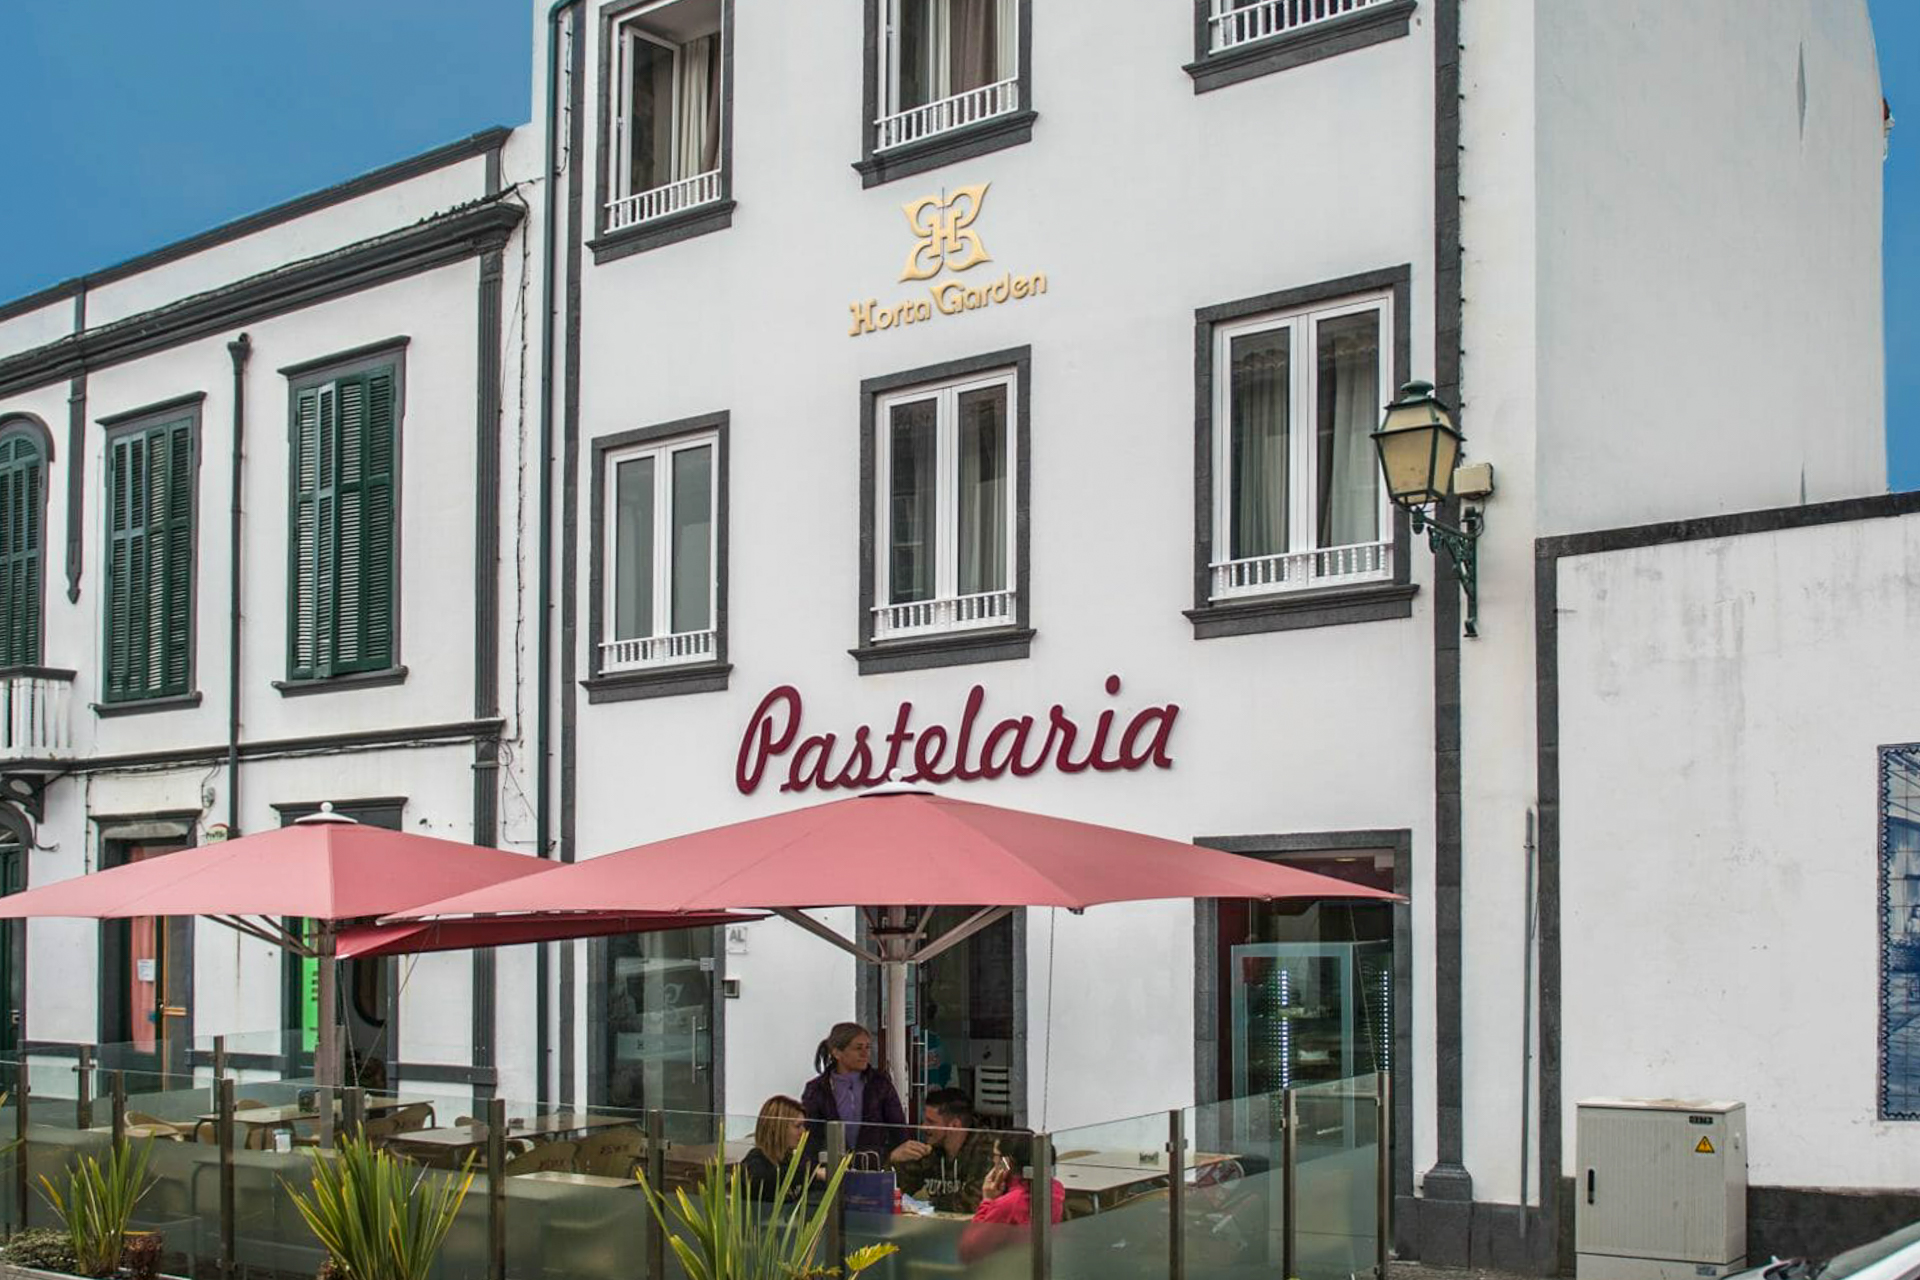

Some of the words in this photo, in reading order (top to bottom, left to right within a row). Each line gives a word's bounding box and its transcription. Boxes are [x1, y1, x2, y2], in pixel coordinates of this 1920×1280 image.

[848, 298, 931, 337] Horta
[929, 271, 1047, 315] Garden
[736, 675, 1179, 795] Pastelaria
[729, 928, 745, 942] AL
